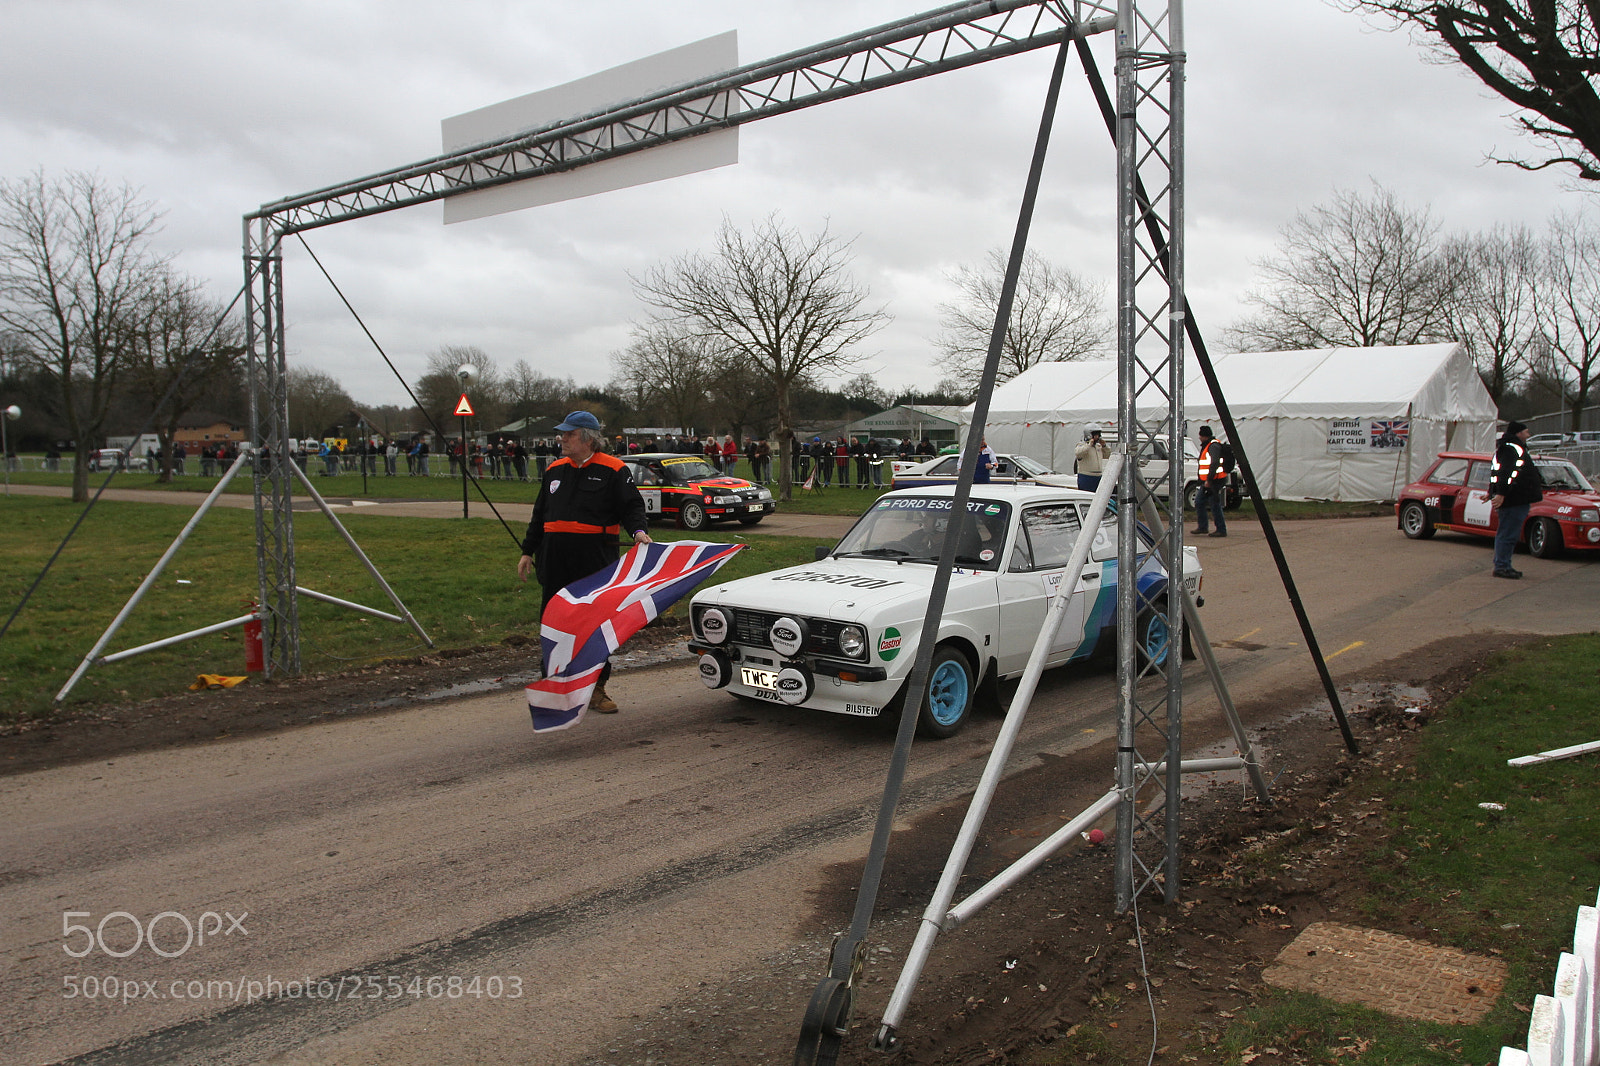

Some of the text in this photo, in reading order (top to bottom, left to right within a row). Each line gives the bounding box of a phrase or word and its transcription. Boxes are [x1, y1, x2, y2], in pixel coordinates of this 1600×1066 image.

[1329, 429, 1363, 437] HISTORIC
[890, 499, 925, 509] FORD
[927, 500, 984, 512] ESCRT
[1424, 496, 1440, 507] elf
[1557, 506, 1573, 514] elf
[772, 571, 904, 590] Castrol
[776, 628, 794, 640] Ford
[772, 638, 796, 649] Motorsport
[880, 637, 902, 651] Castrol
[743, 670, 769, 687] TWC
[755, 689, 783, 702] DUN
[845, 703, 881, 716] BILSTEIN
